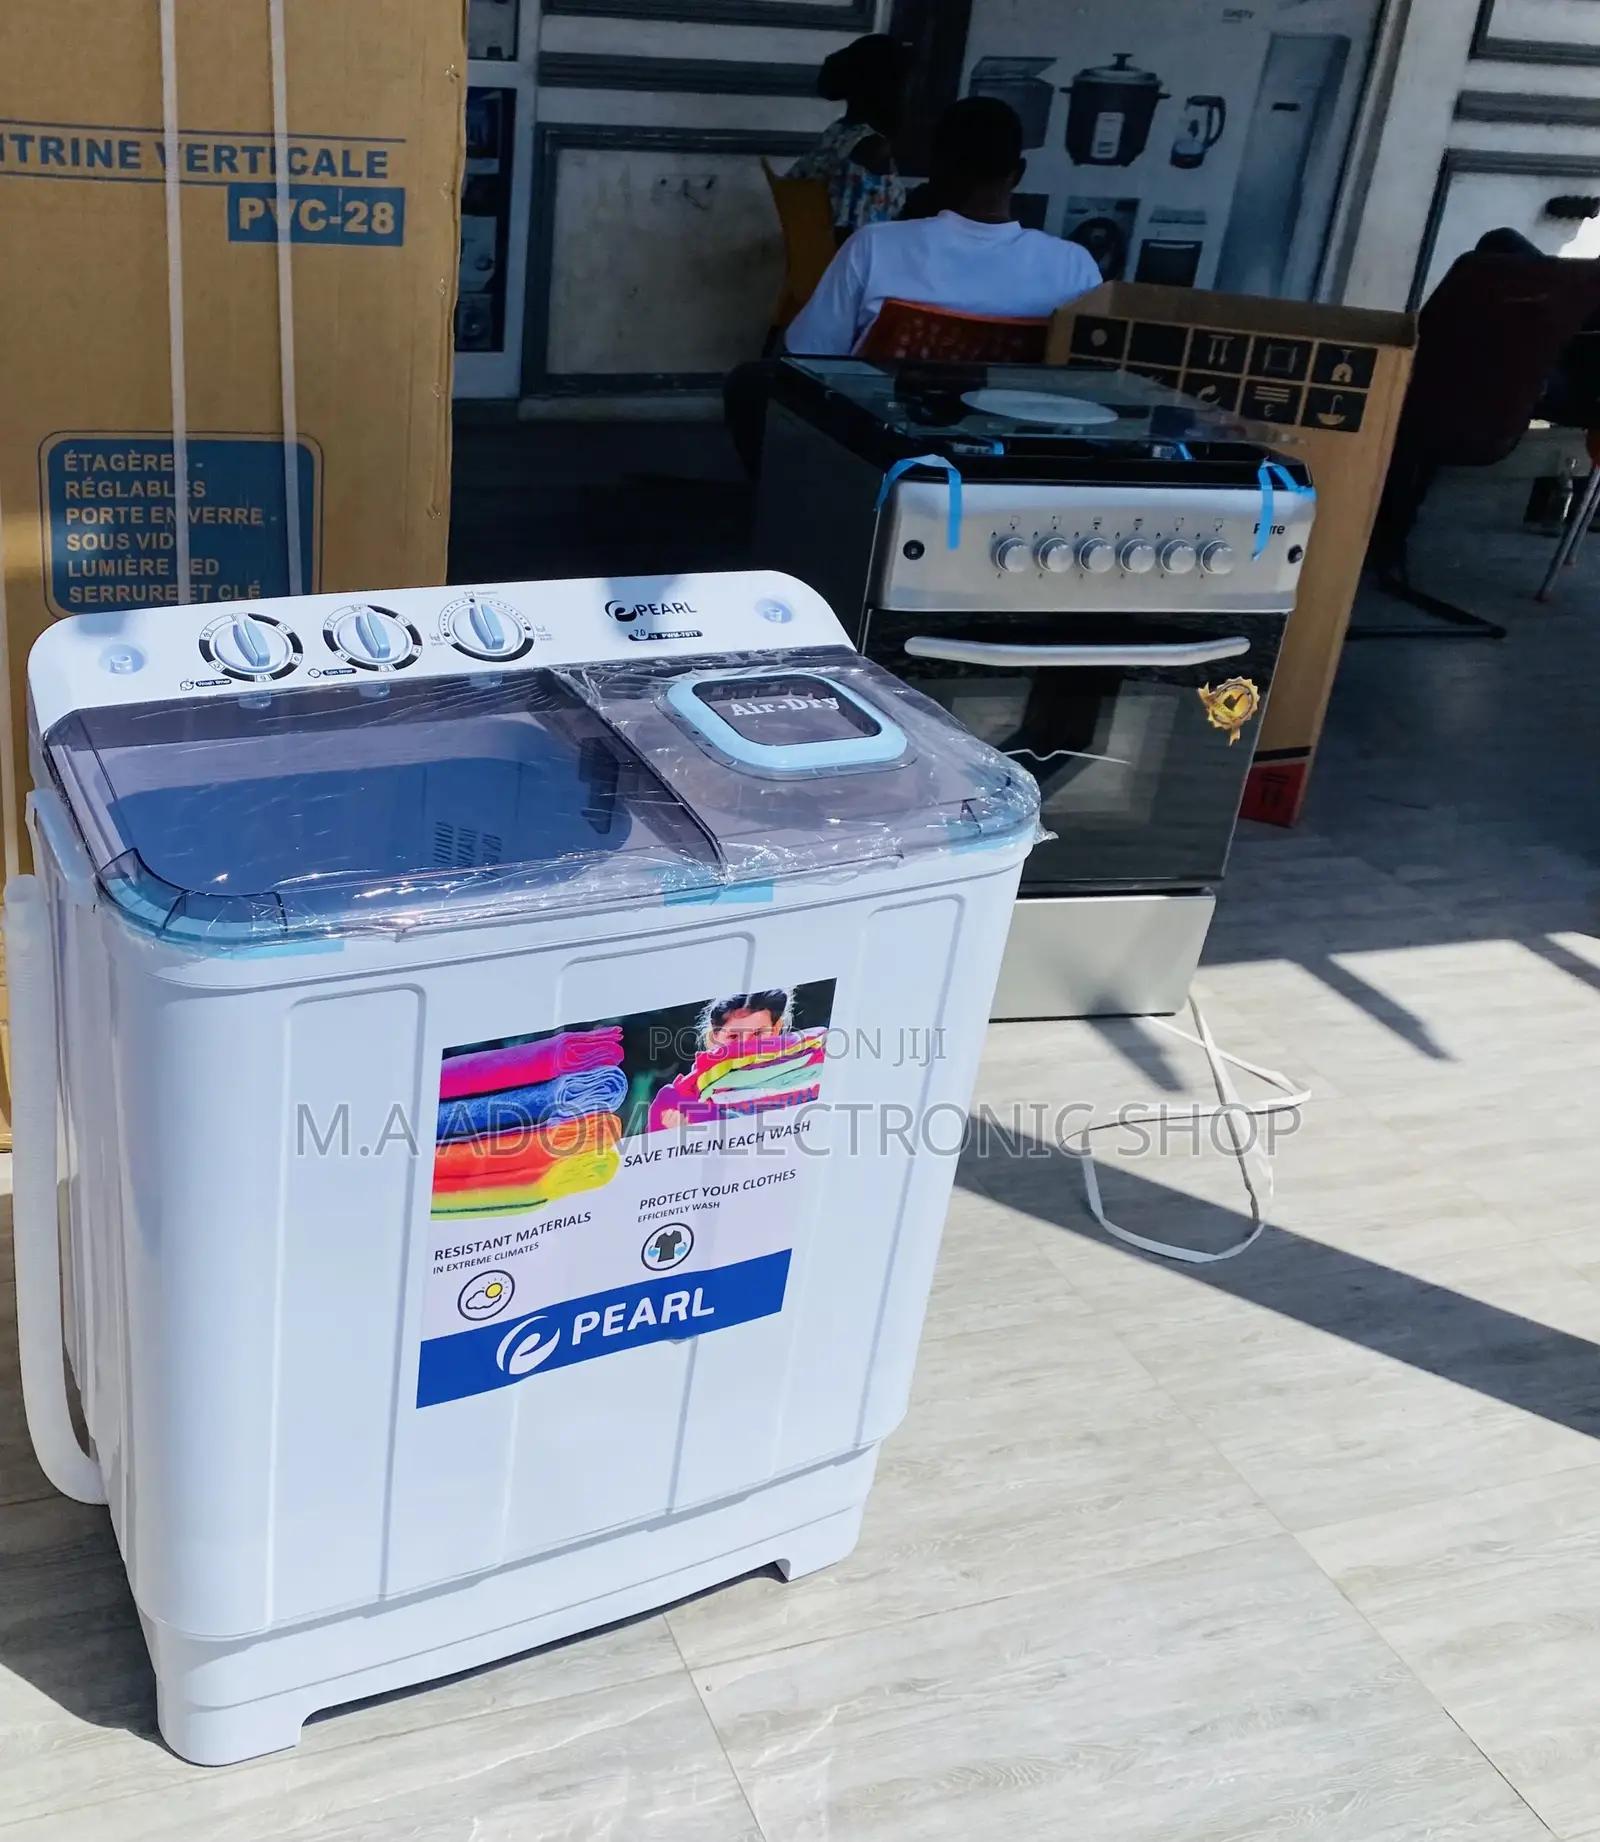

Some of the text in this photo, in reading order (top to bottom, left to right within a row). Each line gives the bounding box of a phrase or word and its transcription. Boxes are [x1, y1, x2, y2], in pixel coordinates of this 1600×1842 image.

[239, 197, 395, 235] PVC-28
[64, 449, 175, 472] ÉTAGÈRE
[65, 477, 206, 499] RÉGLABLS
[66, 506, 144, 525] PORTE
[151, 506, 177, 524] EN
[187, 506, 264, 525] VERRE
[1253, 522, 1286, 536] Pre
[66, 532, 174, 551] SOUS VID
[68, 553, 220, 577] LUMIÈRE ED
[69, 584, 178, 603] SERRURE
[218, 579, 261, 601] CLÉ
[634, 601, 698, 617] PEARL
[729, 697, 840, 717] Air-Dry
[624, 1120, 811, 1168] SAVE TIME IN EACH WASH
[639, 1168, 797, 1210] PROTECT YOUR CLOTHES
[637, 1201, 720, 1223] EFFICIENTLY WASH
[434, 1211, 592, 1261] RESISTANT MATERIALS
[433, 1241, 540, 1275] IN EXTREME CLIMATES
[571, 1287, 715, 1346] PEARL
